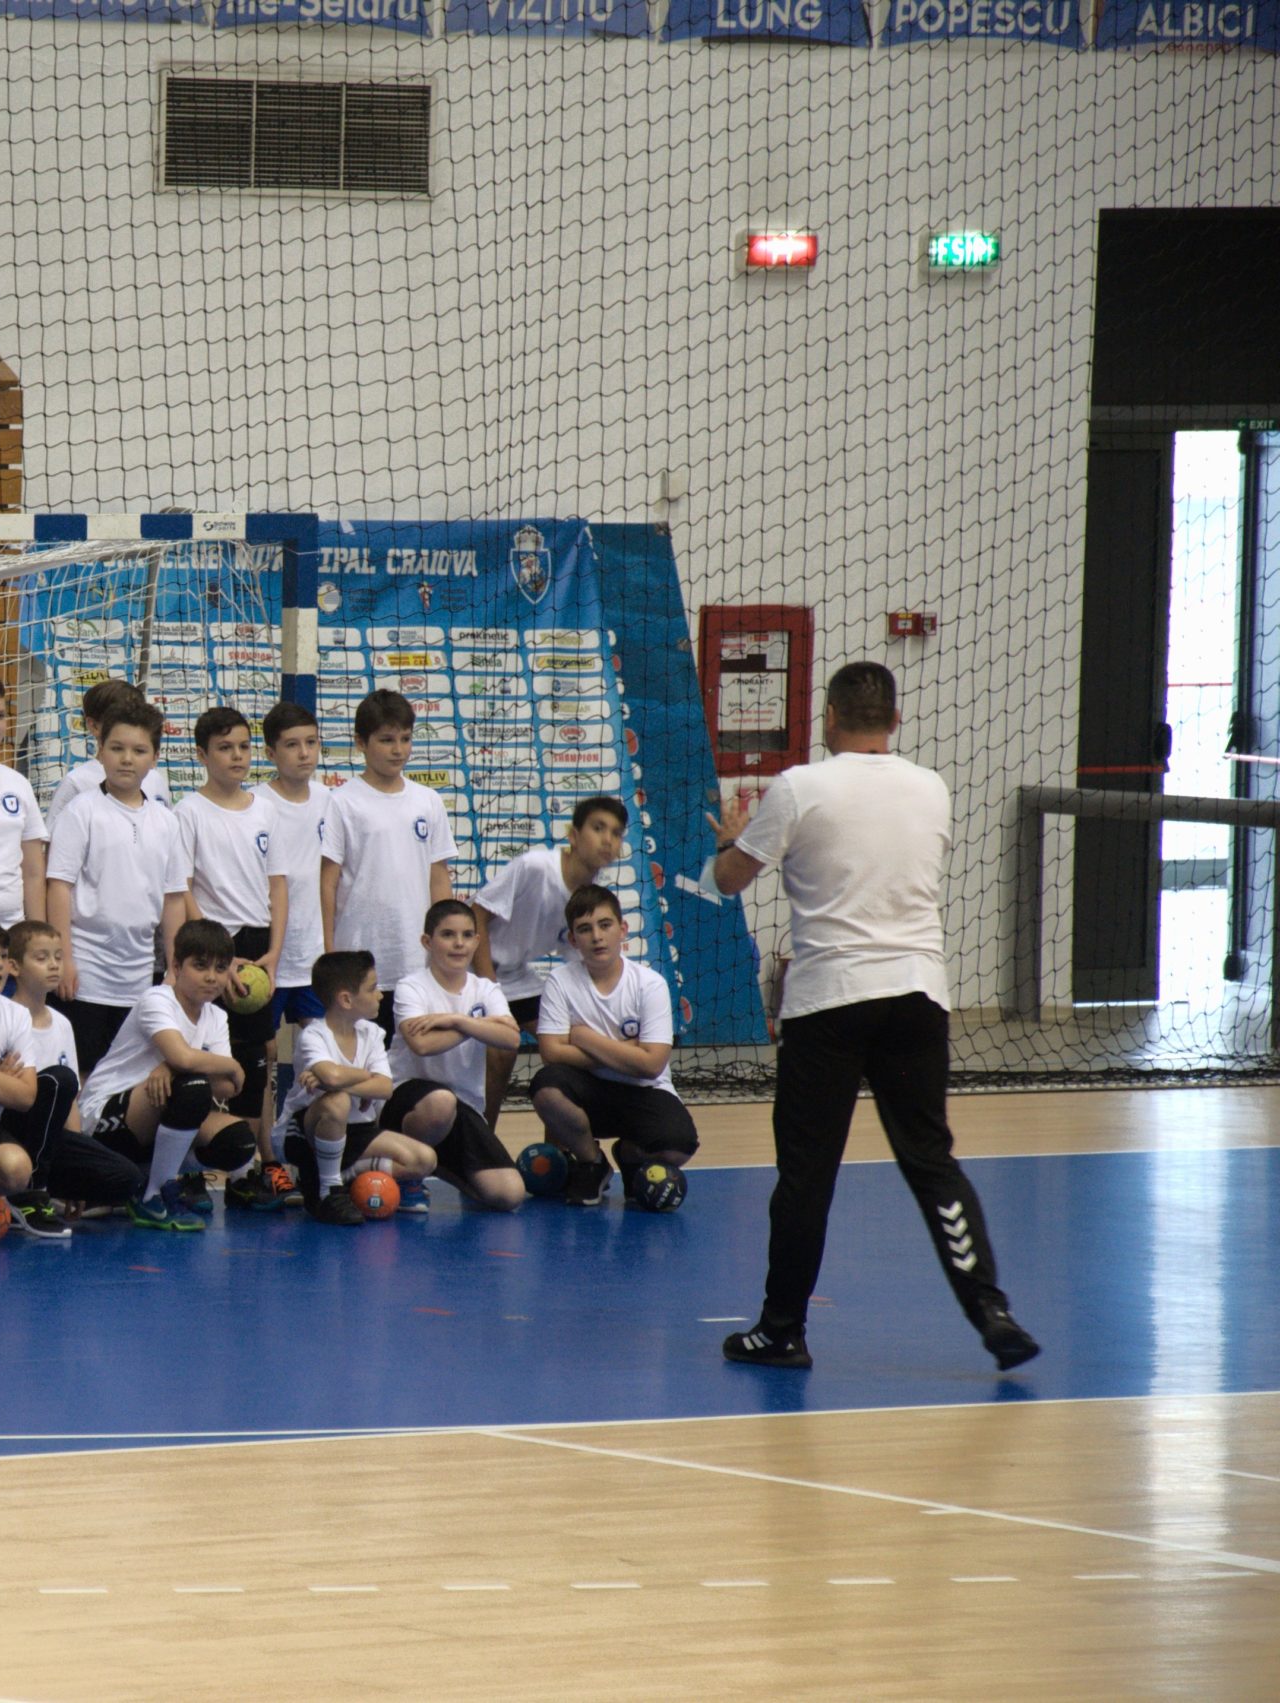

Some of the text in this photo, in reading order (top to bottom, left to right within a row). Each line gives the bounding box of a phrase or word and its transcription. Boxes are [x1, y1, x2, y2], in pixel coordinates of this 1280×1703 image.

[716, 0, 822, 30] LUNG
[895, 0, 1070, 35] POPESCU
[1136, 3, 1255, 38] ALBICI
[387, 549, 478, 577] CRAIOVA
[408, 773, 446, 782] MITLIV
